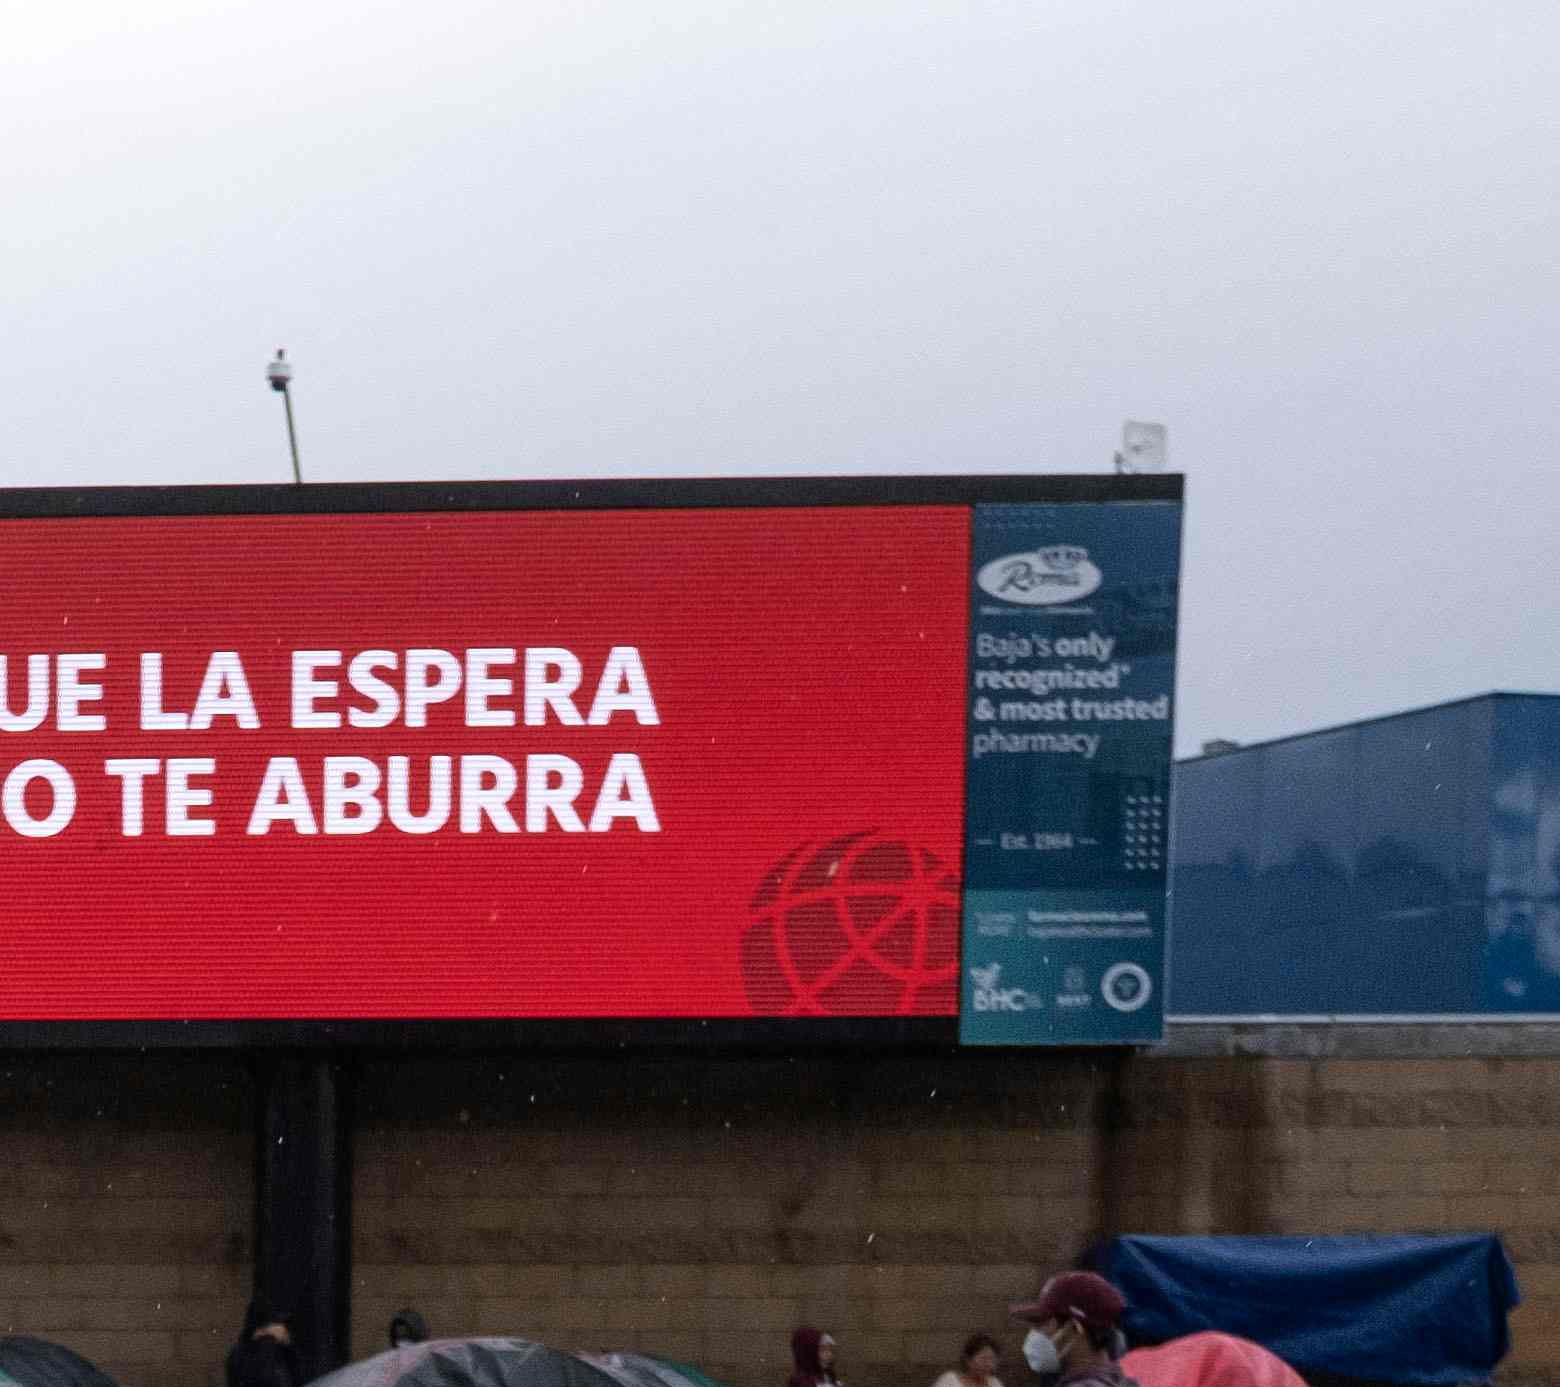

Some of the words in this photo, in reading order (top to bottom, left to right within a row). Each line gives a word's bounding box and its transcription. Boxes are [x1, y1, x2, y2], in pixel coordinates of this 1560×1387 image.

[976, 632, 1052, 664] Baja's
[1054, 630, 1116, 662] only
[139, 651, 261, 731] LA
[290, 645, 662, 729] ESPERA
[973, 696, 996, 721] &
[999, 698, 1068, 721] most
[1071, 694, 1169, 720] trusted
[972, 727, 1101, 758] pharmacy
[104, 757, 217, 837] TE
[245, 752, 662, 836] ABURRA
